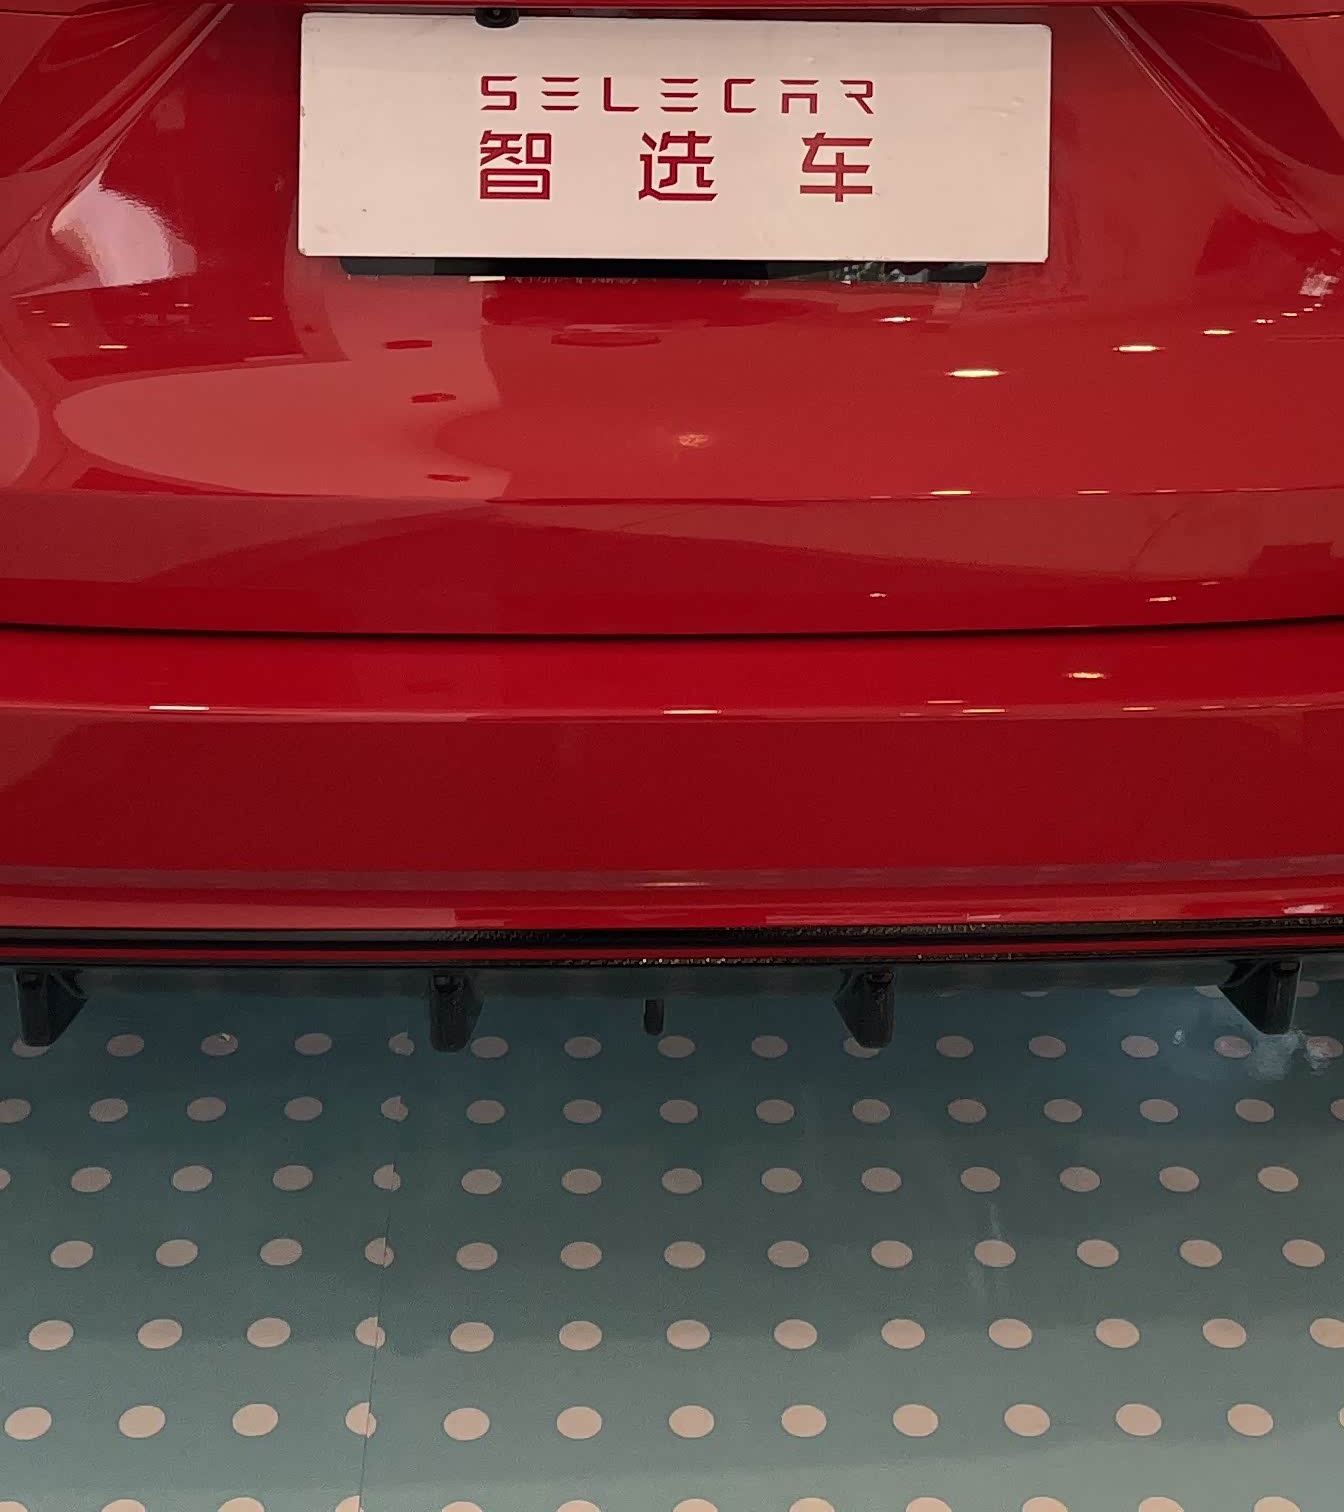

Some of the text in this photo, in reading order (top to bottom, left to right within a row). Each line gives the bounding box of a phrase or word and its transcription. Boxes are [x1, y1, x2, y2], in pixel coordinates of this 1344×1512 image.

[479, 74, 875, 115] SELECAR
[479, 129, 874, 203] 智选车
